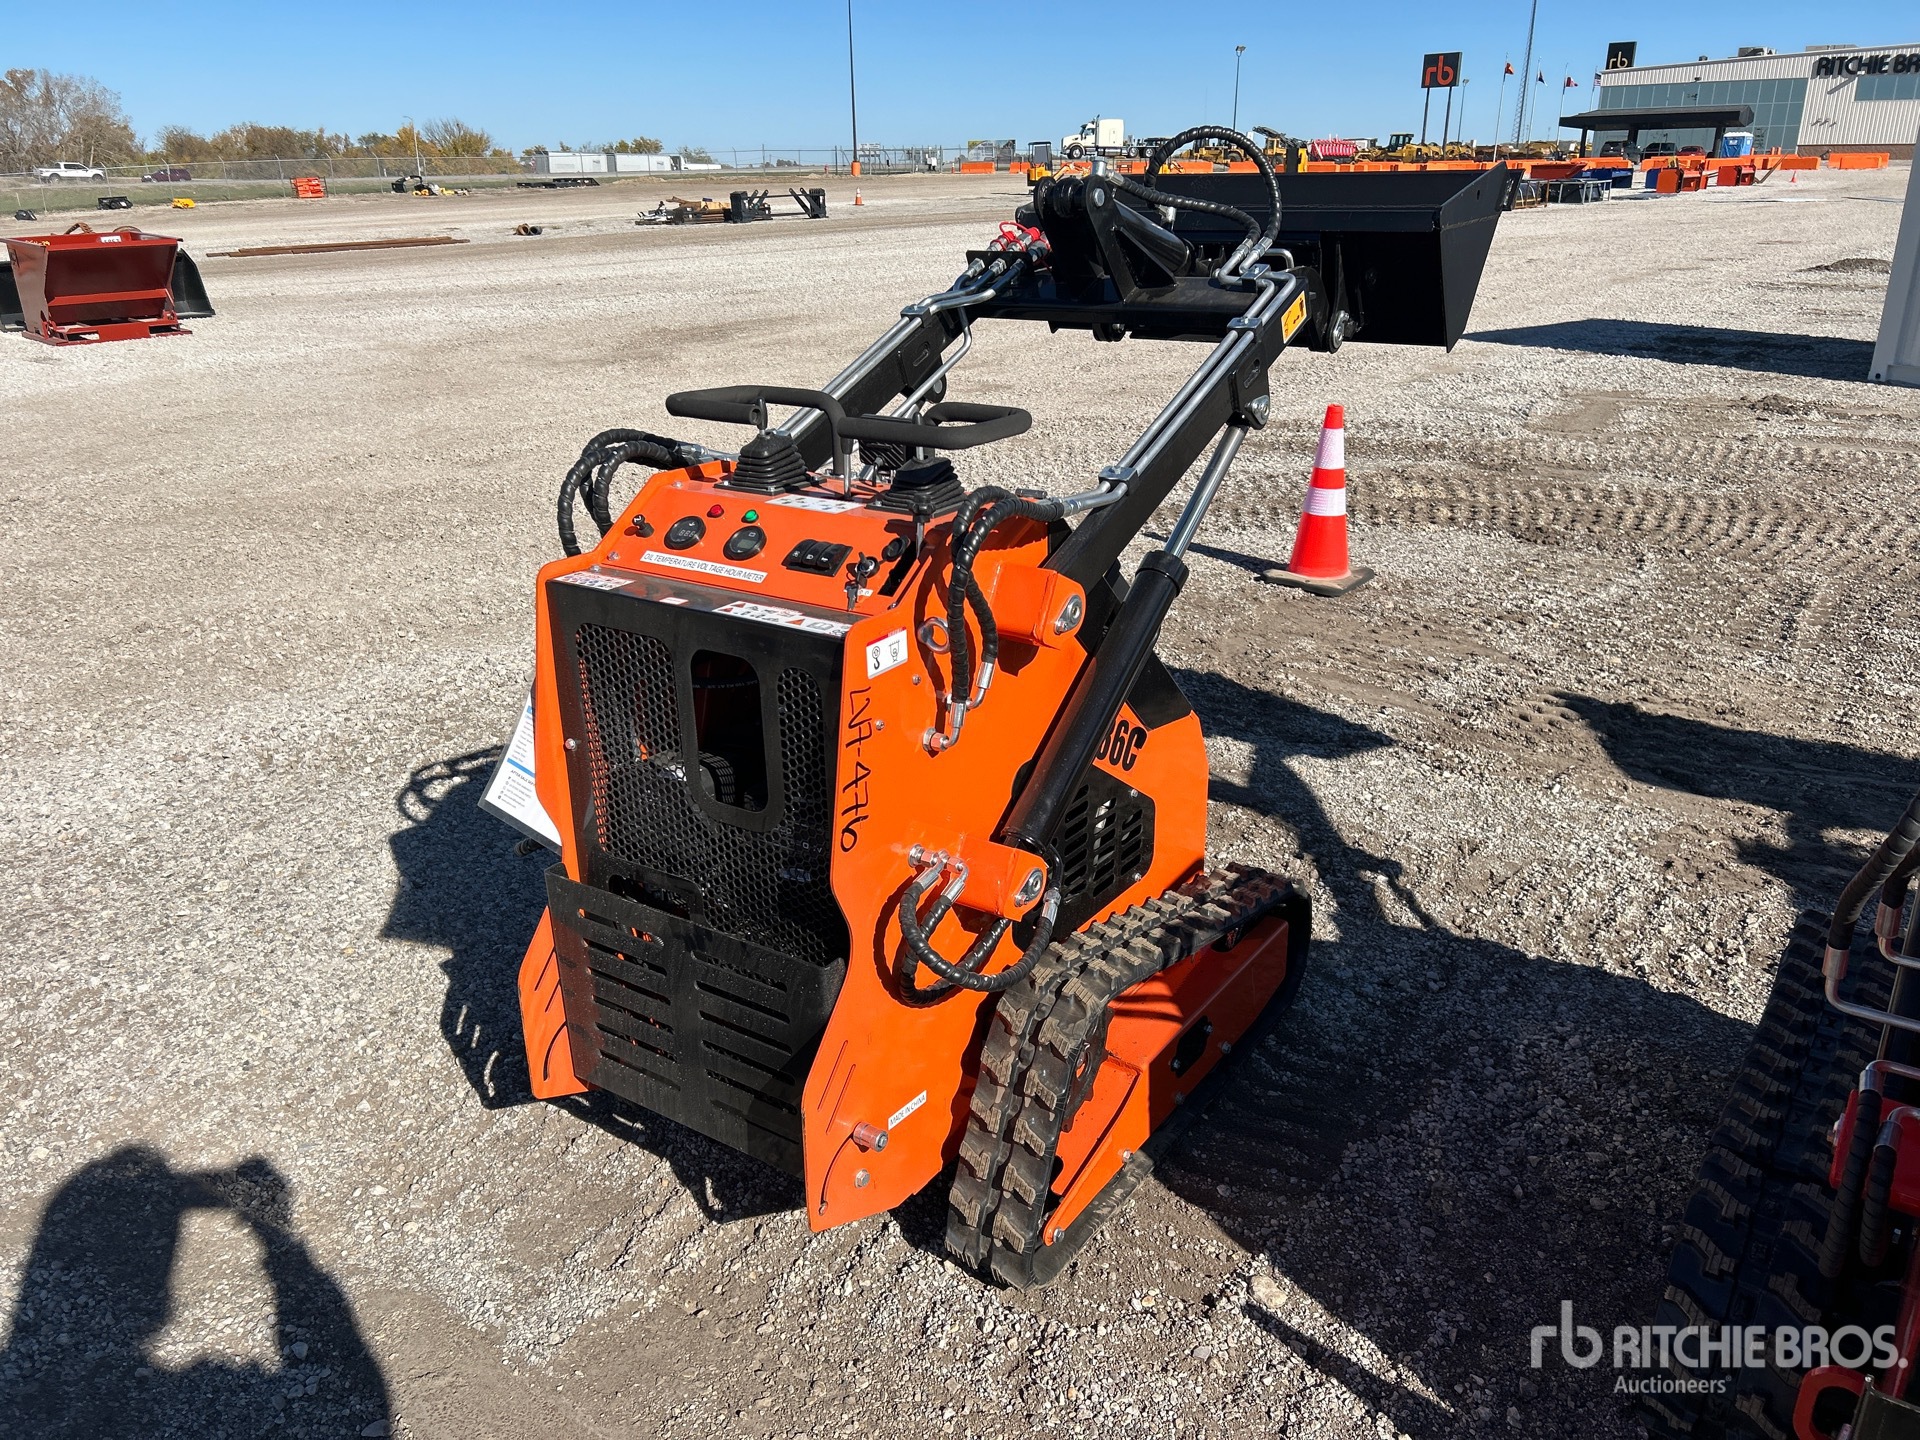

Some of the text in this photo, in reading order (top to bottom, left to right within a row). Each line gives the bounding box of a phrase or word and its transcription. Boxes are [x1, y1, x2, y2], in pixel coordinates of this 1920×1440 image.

[1424, 55, 1454, 86] rb
[1609, 51, 1629, 69] rb
[1816, 54, 1891, 76] RITCHIE
[643, 553, 653, 561] OIL
[654, 554, 697, 569] TEMPERATURE
[723, 567, 744, 577] HOUR
[740, 571, 764, 581] METER
[890, 1110, 904, 1126] MADE
[911, 1095, 925, 1110] CHINA
